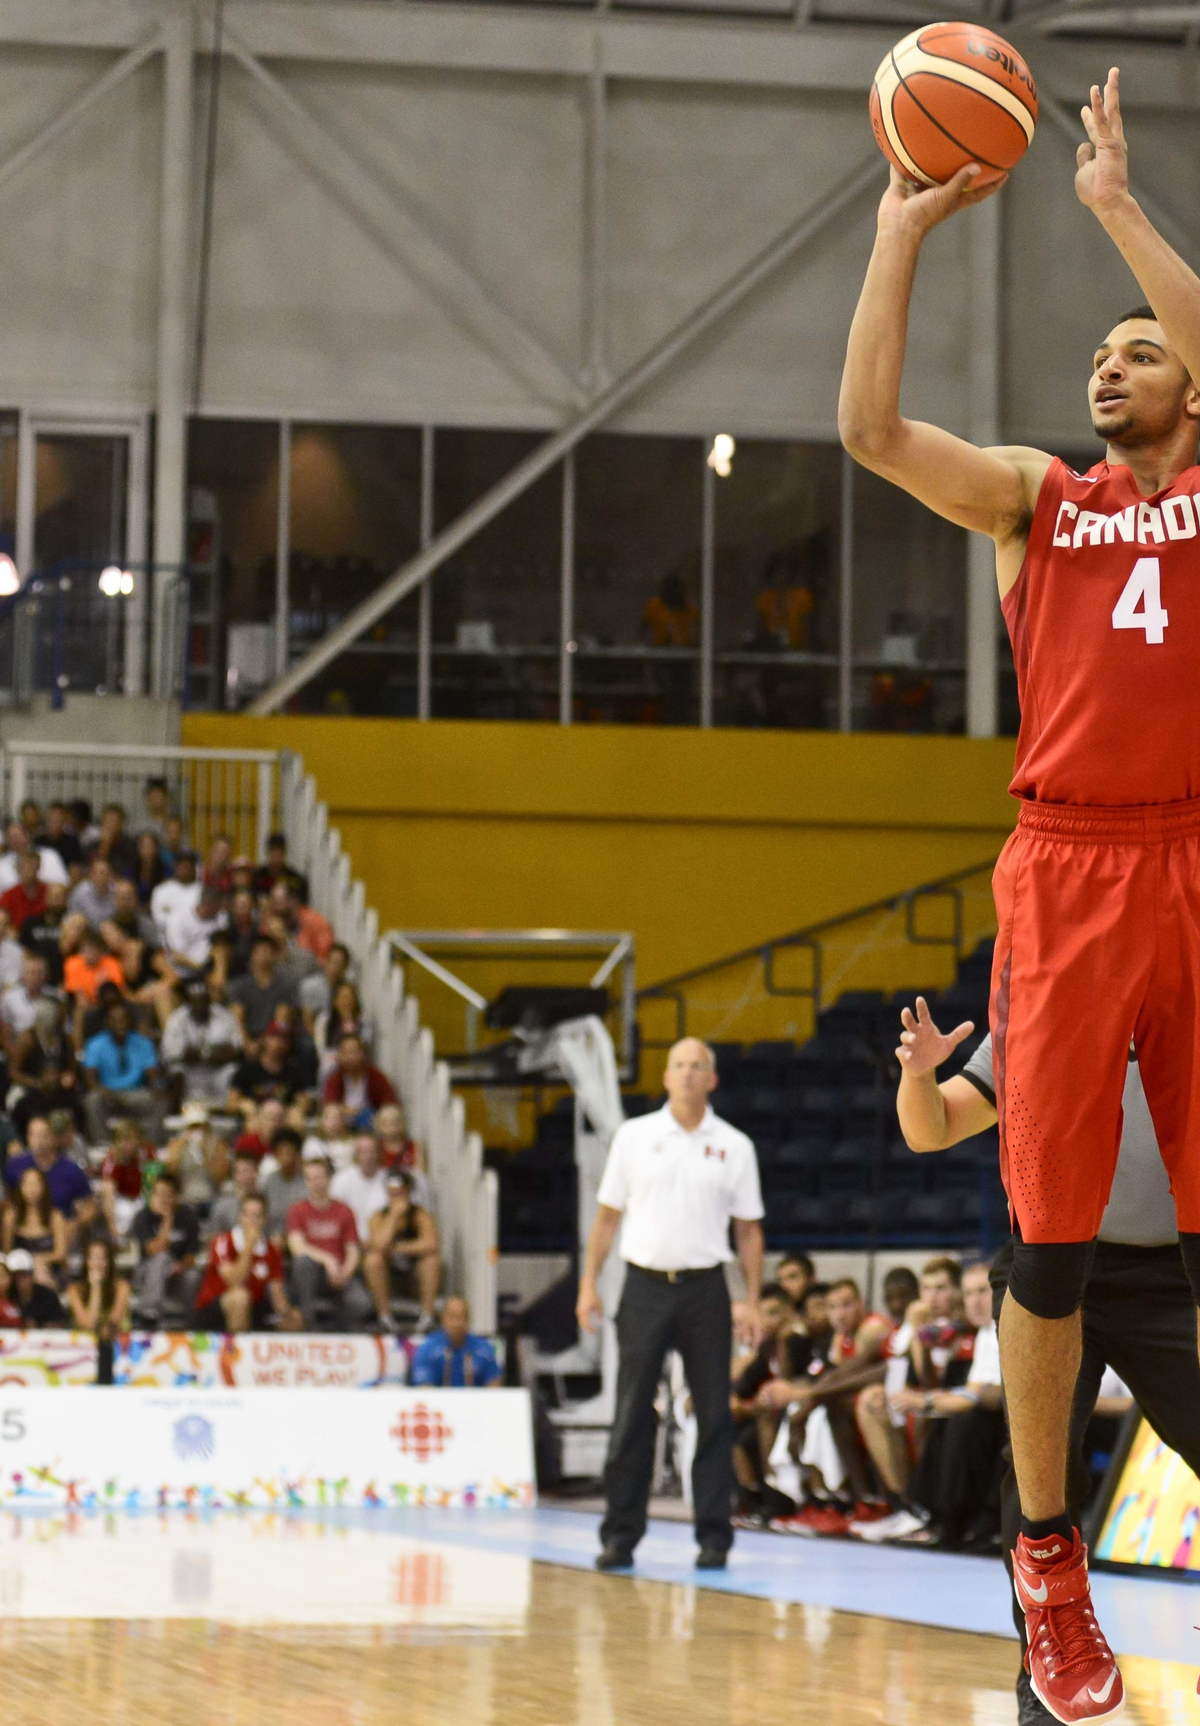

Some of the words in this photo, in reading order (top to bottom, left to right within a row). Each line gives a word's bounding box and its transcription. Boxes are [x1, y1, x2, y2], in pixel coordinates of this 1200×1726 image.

[1111, 557, 1169, 645] 4
[251, 1340, 358, 1365] UNITED
[251, 1367, 286, 1387] WE
